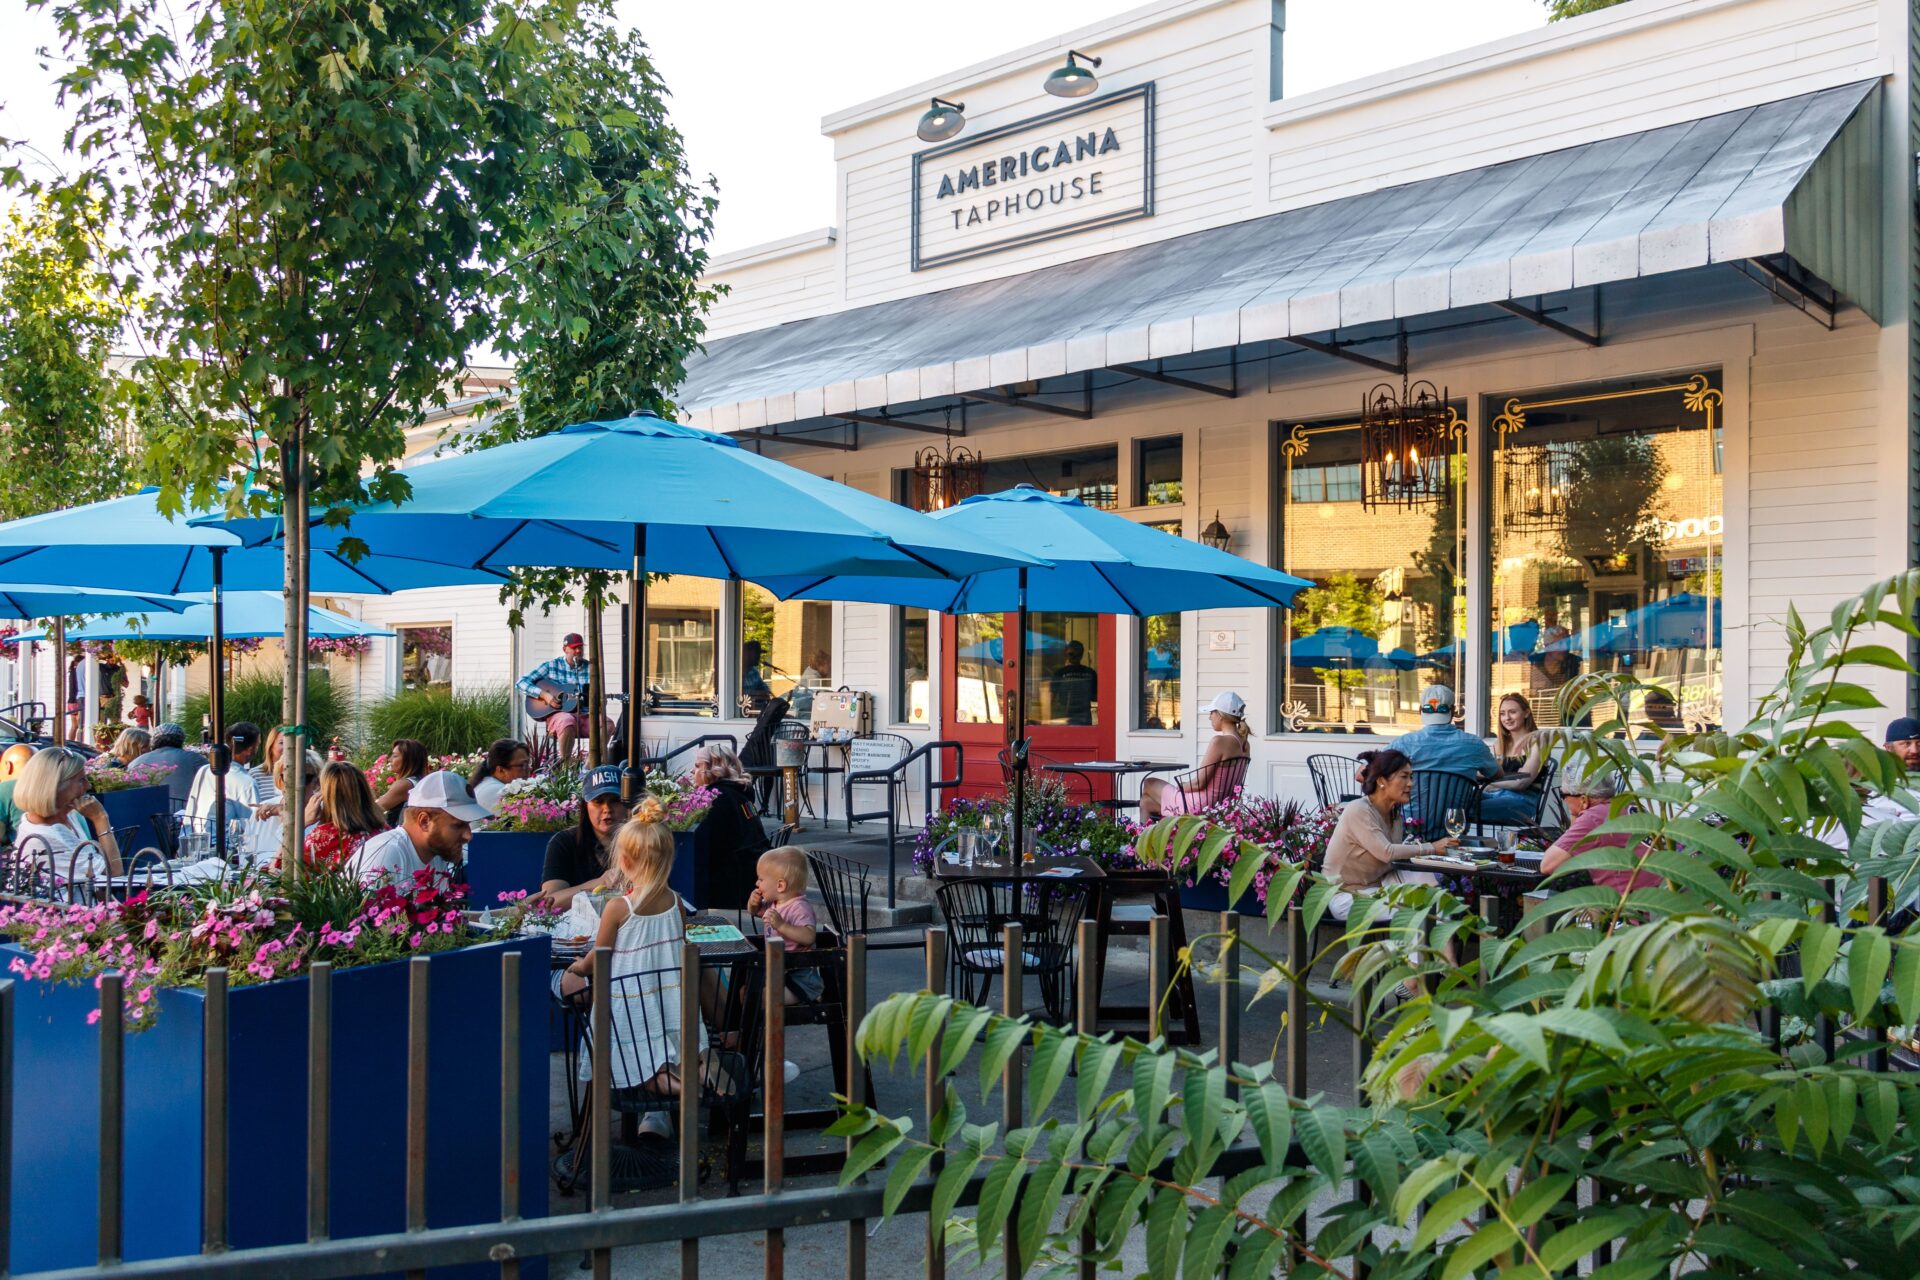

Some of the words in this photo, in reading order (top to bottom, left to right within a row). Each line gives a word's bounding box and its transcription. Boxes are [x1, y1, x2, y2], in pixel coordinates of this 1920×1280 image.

[937, 127, 1120, 199] AMERICANA
[951, 172, 1103, 230] TAPHOUSE
[592, 771, 619, 787] NASH
